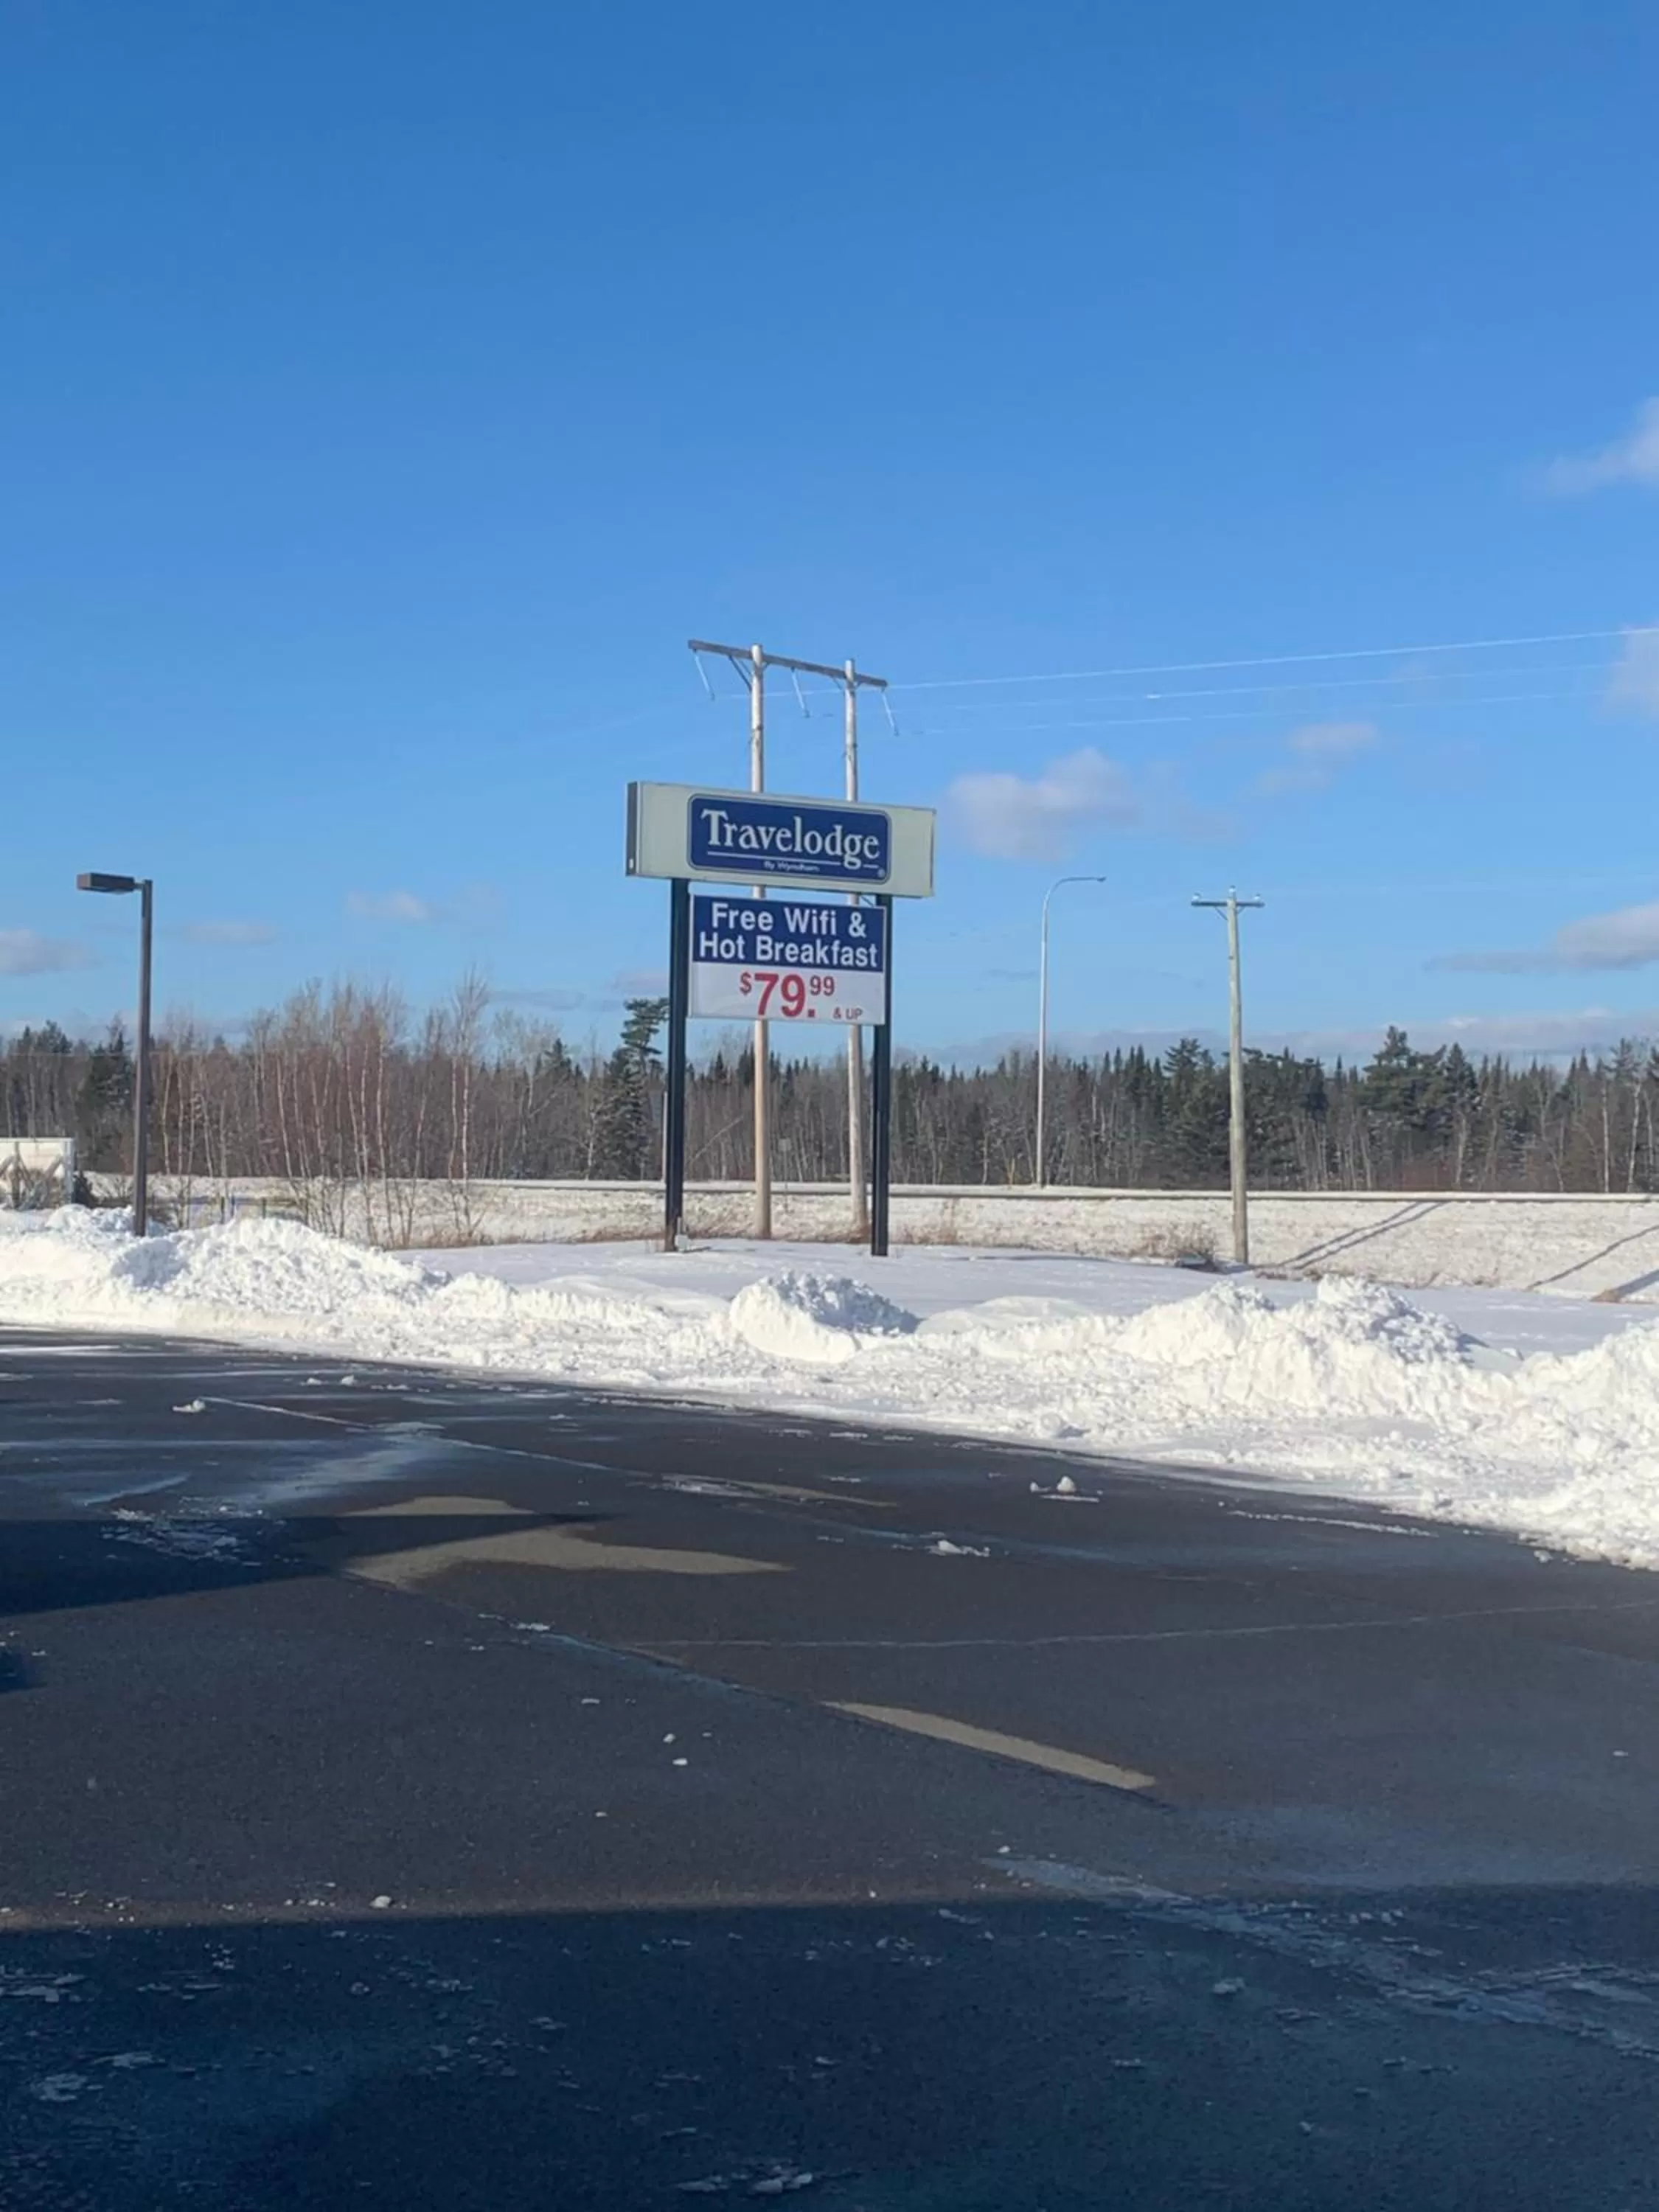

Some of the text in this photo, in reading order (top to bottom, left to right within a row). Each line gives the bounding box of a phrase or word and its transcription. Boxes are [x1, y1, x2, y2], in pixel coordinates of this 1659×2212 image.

[701, 809, 879, 868] Travelodge
[712, 902, 866, 938] Free Wifi &
[699, 932, 877, 967] Hot Breakfast
[833, 1006, 863, 1020] & UP
